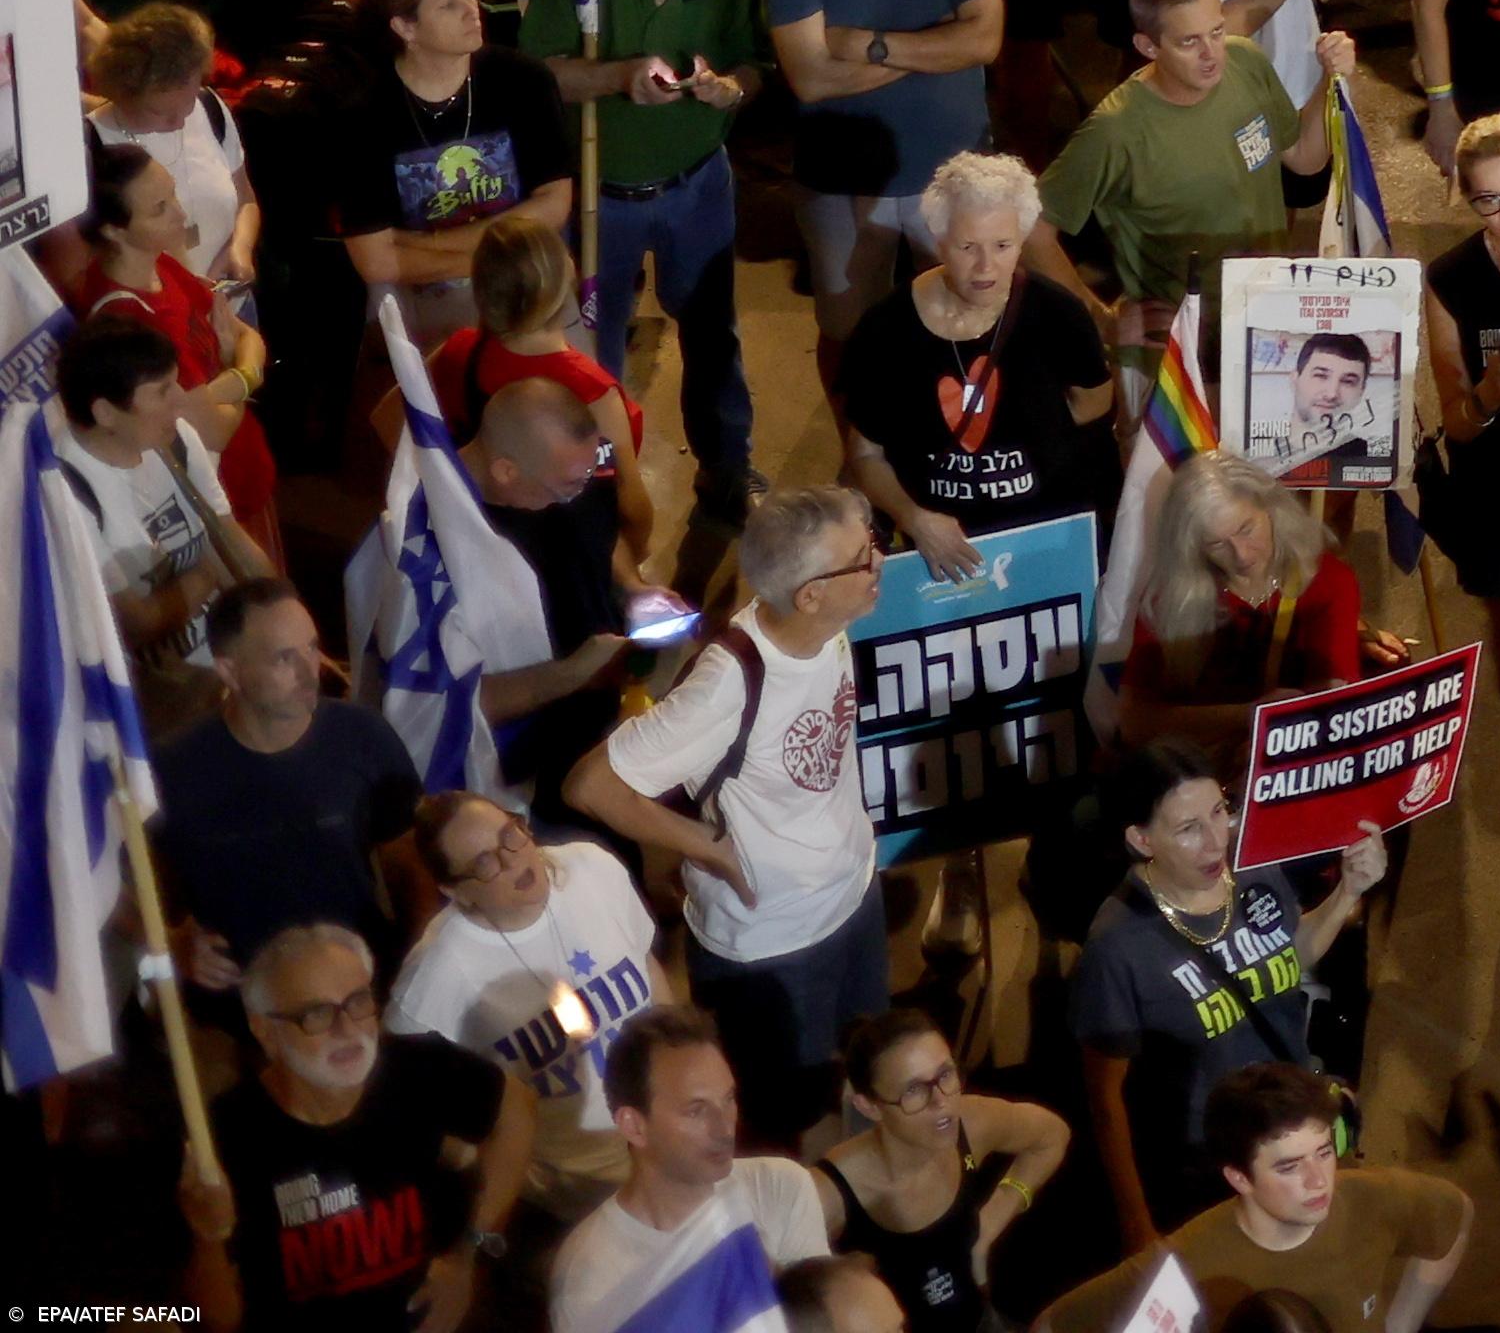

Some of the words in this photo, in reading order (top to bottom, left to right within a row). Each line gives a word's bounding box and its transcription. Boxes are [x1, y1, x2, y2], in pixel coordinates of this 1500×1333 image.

[428, 173, 503, 221] Buffy
[1265, 719, 1320, 758] OUR
[1327, 695, 1418, 744] SISTERS
[1420, 672, 1466, 715] ARE
[1252, 755, 1356, 805] CALLING
[1360, 737, 1406, 778] FOR
[1409, 714, 1464, 760] HELP
